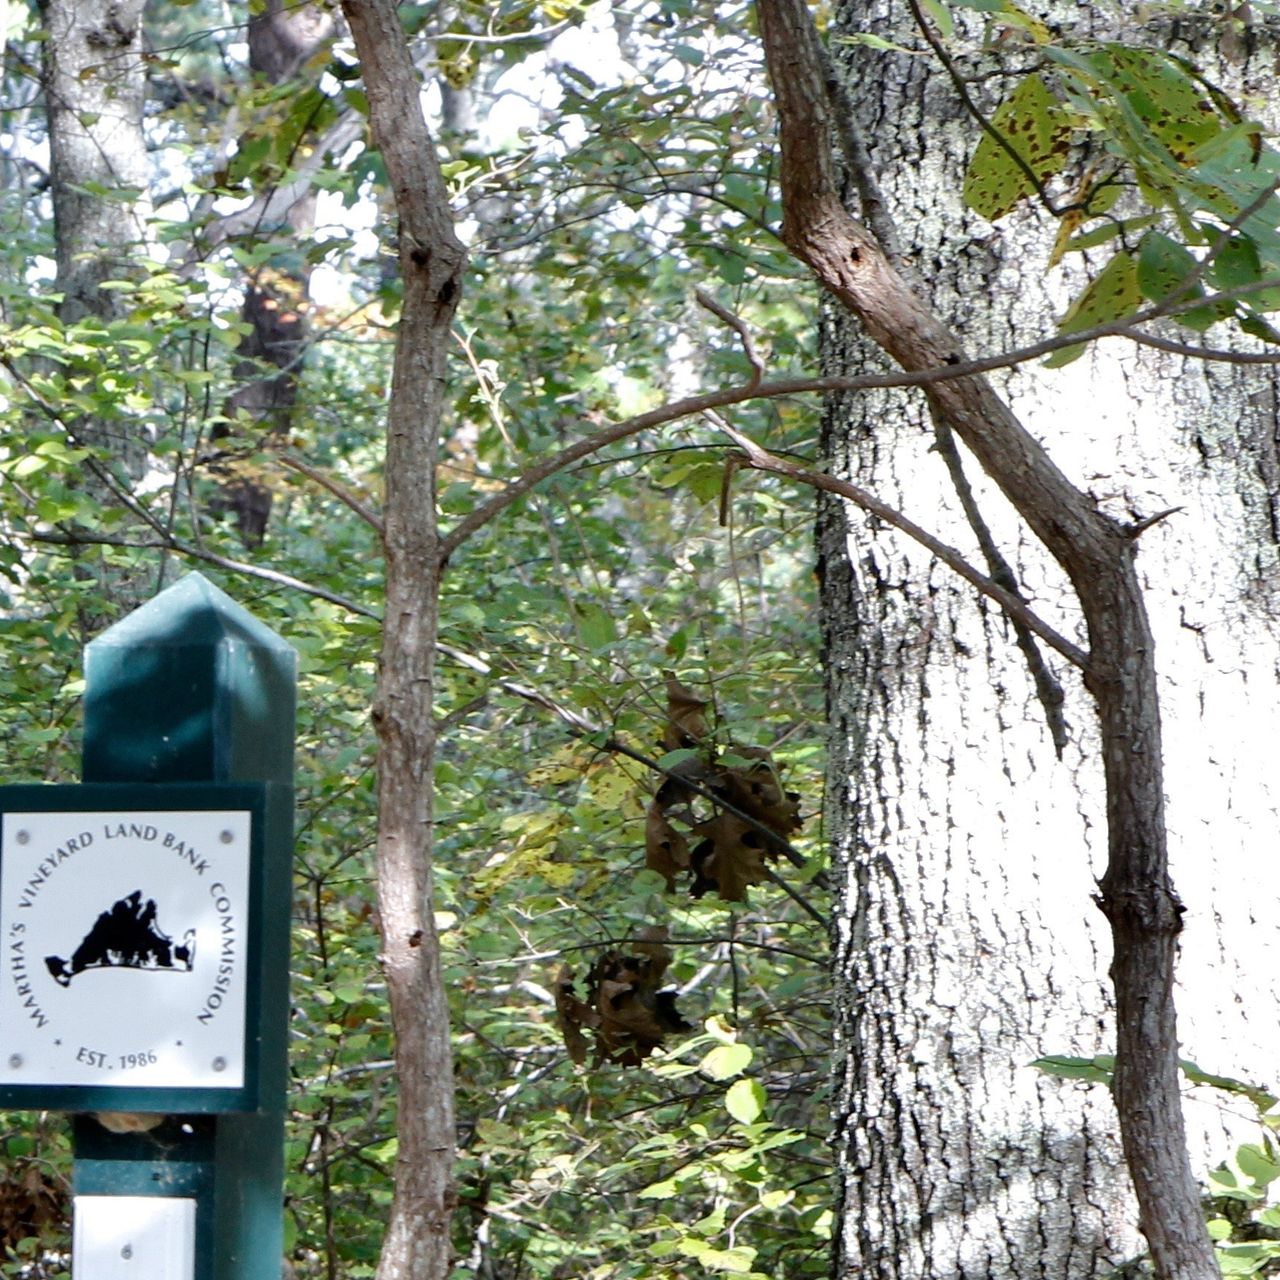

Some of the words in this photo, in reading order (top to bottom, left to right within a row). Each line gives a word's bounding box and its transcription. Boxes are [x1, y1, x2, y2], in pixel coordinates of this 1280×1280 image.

[103, 823, 158, 842] LAND
[162, 832, 211, 876] BANK
[18, 831, 93, 909] VINEYARD
[9, 922, 49, 1028] MARTHA'S
[196, 882, 235, 1026] COMMISSION
[75, 1046, 114, 1070] EST.
[119, 1049, 157, 1070] 1986
